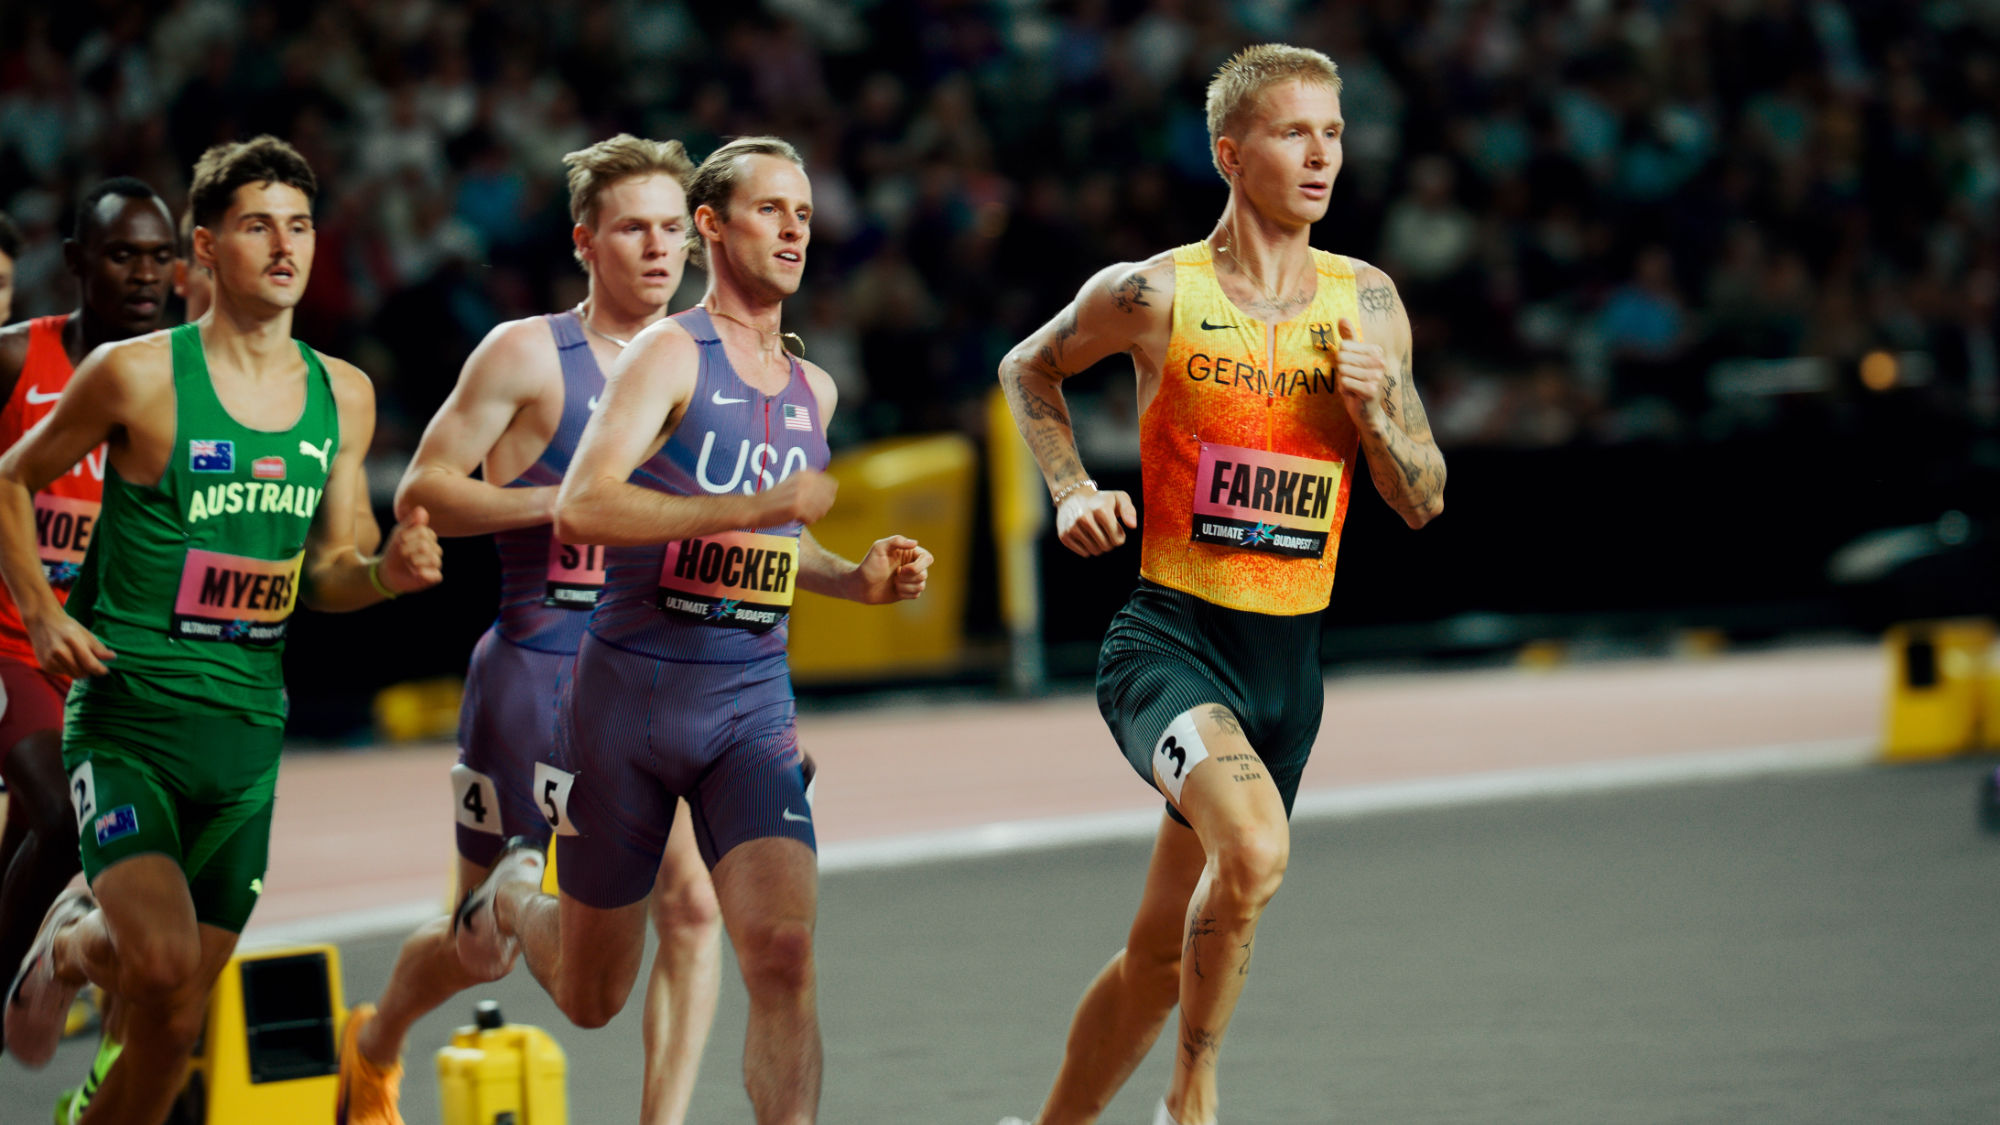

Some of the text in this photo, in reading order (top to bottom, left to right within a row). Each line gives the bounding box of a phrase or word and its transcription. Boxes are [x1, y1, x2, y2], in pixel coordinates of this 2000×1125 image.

[1187, 353, 1335, 397] GERMAN
[1209, 460, 1333, 519] FARKEN
[36, 507, 91, 552] KOE
[1202, 522, 1244, 540] ULTIMATE
[1273, 534, 1312, 550] BUDAPEST
[674, 539, 791, 593] HOCKER
[199, 566, 295, 611] MYERS
[664, 596, 709, 616] ULTIMATE
[735, 608, 776, 624] BUDAPEST
[1161, 735, 1186, 779] 3
[1240, 763, 1249, 771] IT
[74, 778, 91, 823] 2
[463, 782, 487, 823] 4
[544, 779, 559, 827] 5
